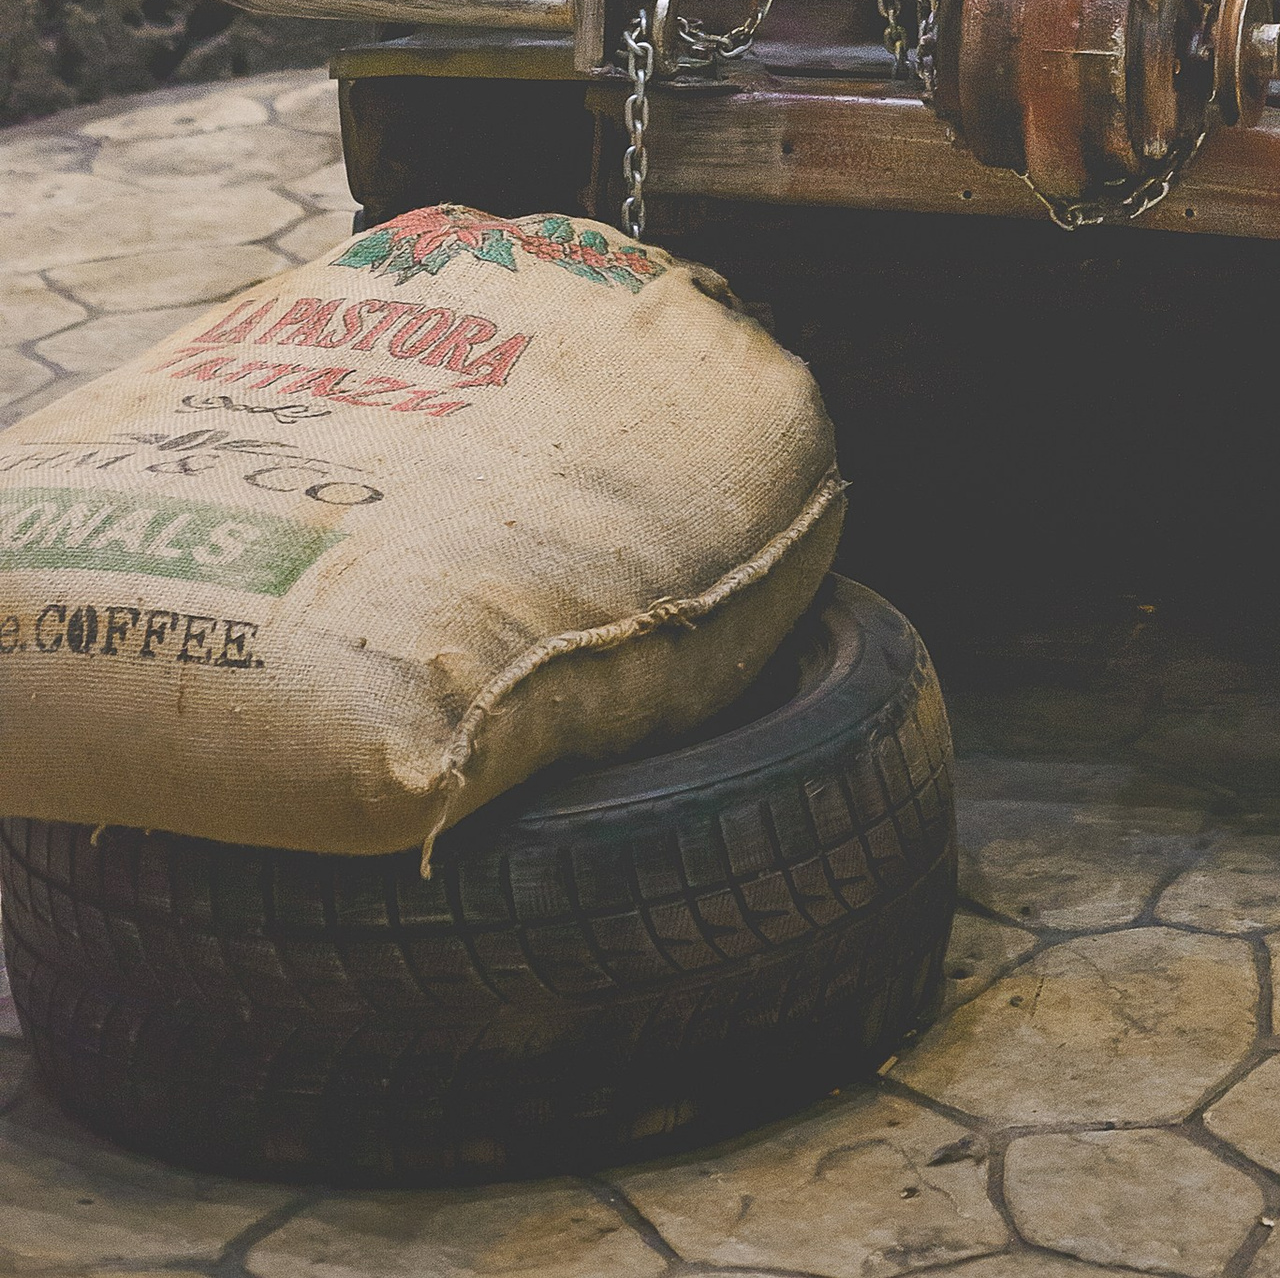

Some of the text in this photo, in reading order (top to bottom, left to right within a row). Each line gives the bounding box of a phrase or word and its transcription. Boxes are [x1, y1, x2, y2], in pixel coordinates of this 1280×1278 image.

[189, 296, 537, 389] LA PASTORA
[242, 465, 385, 506] CO
